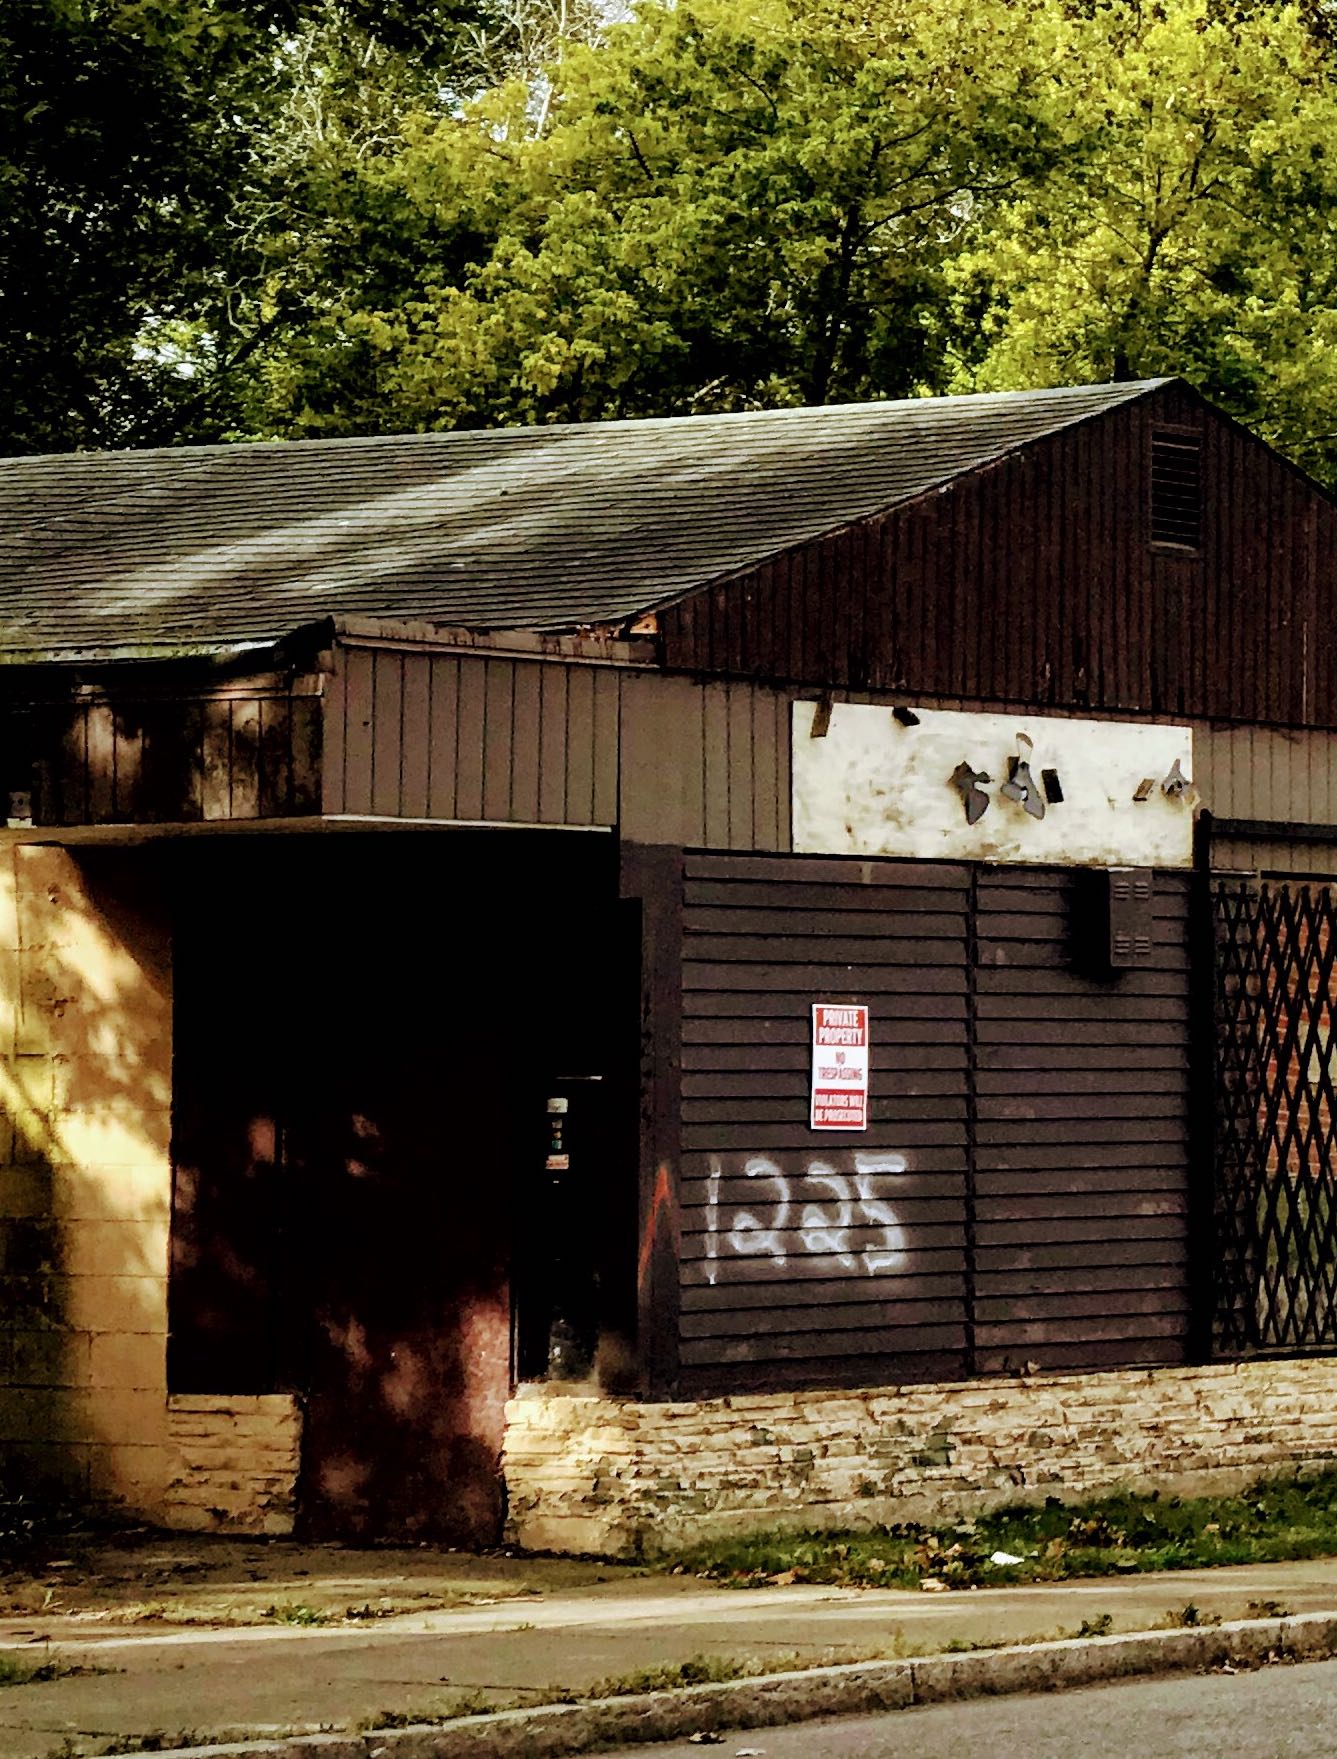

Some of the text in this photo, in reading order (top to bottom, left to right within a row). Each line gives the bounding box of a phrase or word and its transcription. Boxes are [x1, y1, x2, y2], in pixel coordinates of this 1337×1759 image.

[822, 1009, 859, 1027] PRIVATE
[818, 1027, 863, 1045] PROPERTY
[835, 1051, 846, 1065] NO
[703, 1152, 908, 1286] 1225
